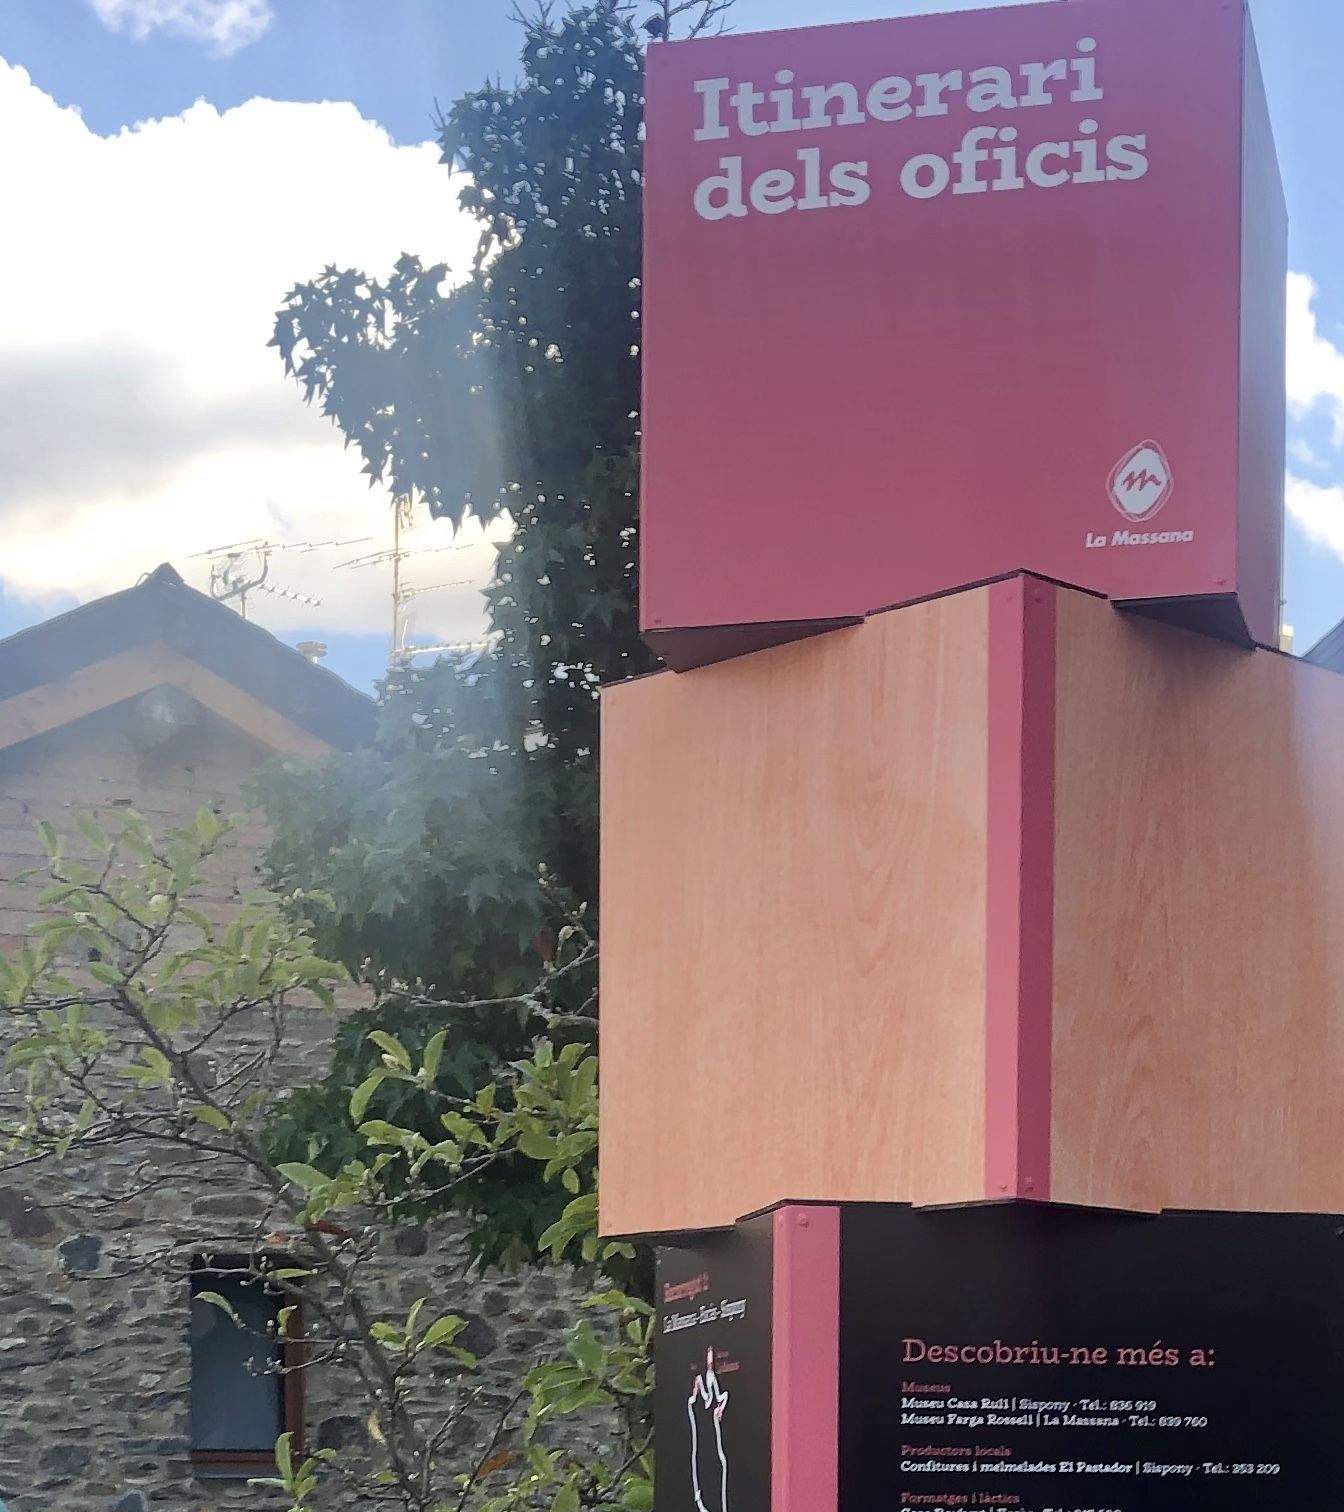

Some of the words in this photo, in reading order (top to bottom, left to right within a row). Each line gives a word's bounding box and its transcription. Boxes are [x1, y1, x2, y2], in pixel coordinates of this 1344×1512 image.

[692, 37, 1103, 141] Itinerari
[692, 147, 871, 221] dels
[899, 118, 1149, 200] oficis
[1086, 532, 1107, 548] La
[1111, 530, 1194, 546] Massana
[902, 1338, 1107, 1364] Descobriu-ne
[1116, 1339, 1179, 1366] més
[1189, 1348, 1214, 1366] a:
